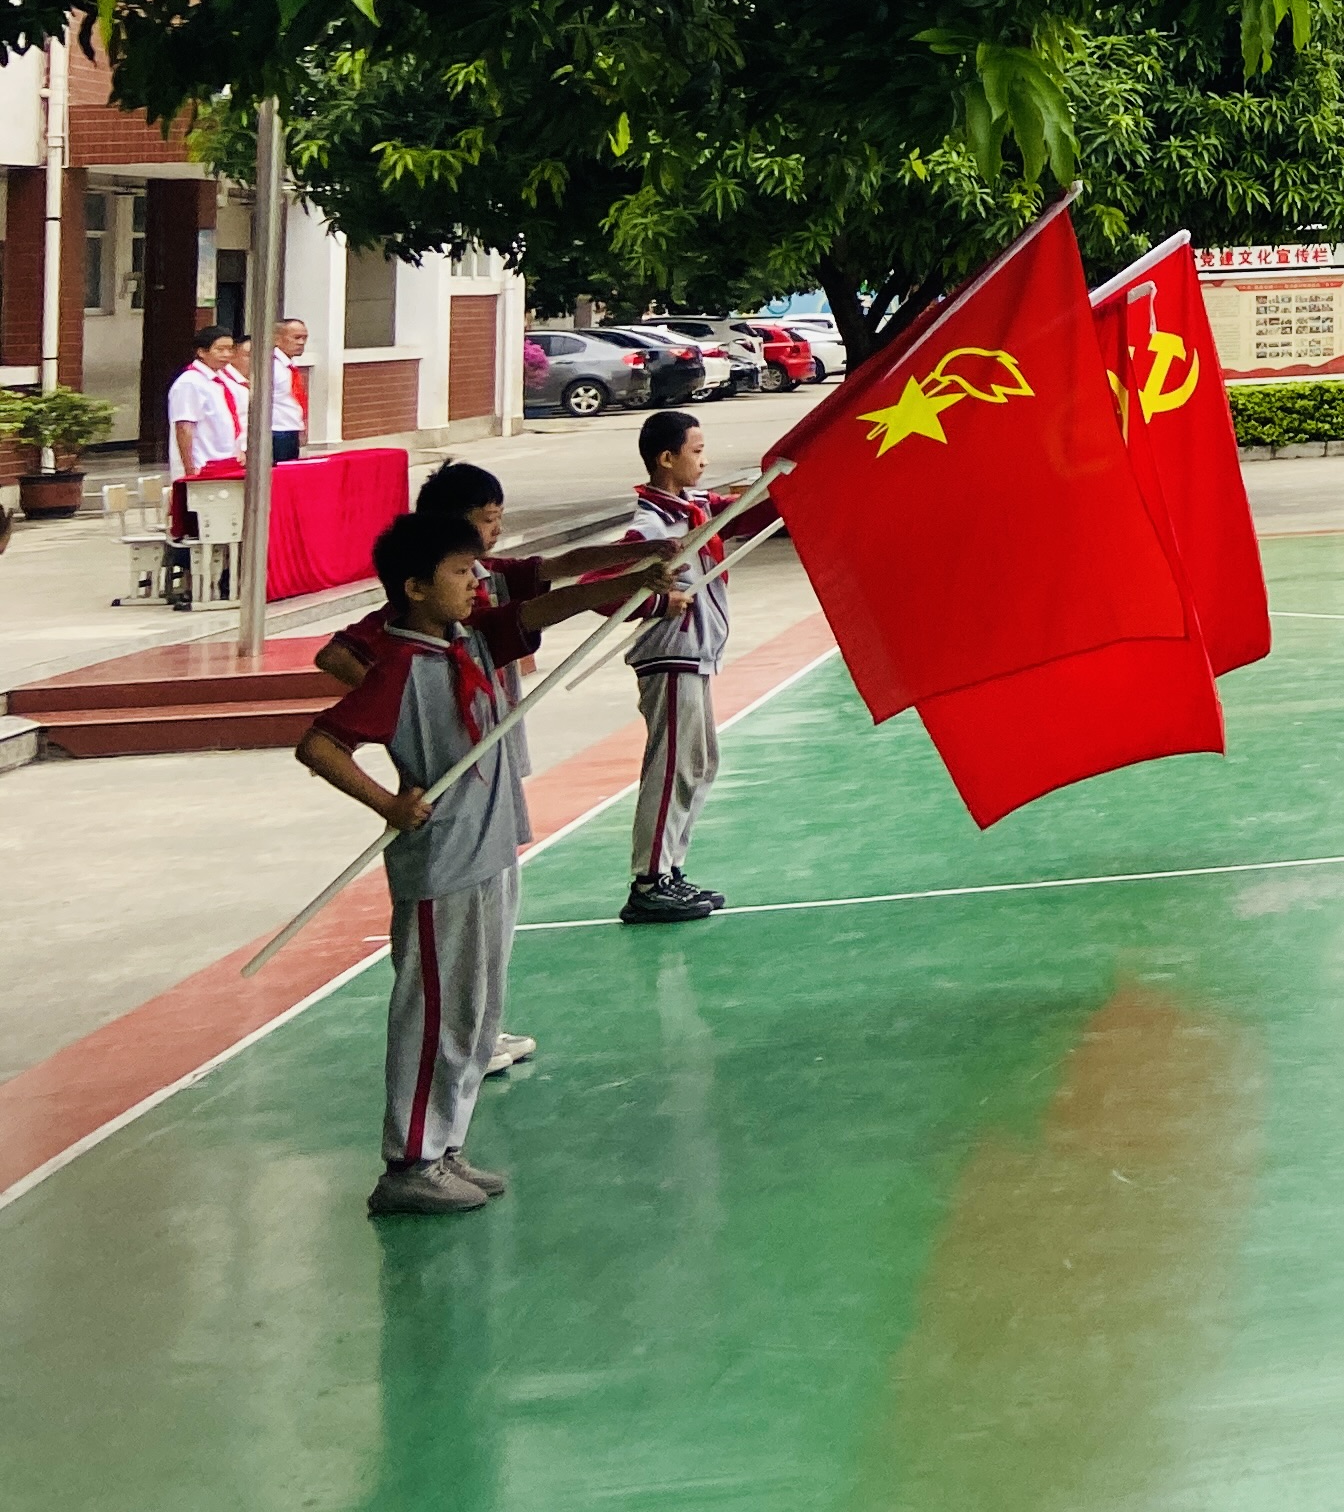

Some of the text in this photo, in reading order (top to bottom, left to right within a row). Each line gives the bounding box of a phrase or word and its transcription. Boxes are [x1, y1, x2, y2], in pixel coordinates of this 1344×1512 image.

[1200, 248, 1329, 267] 党建文化宣传栏
